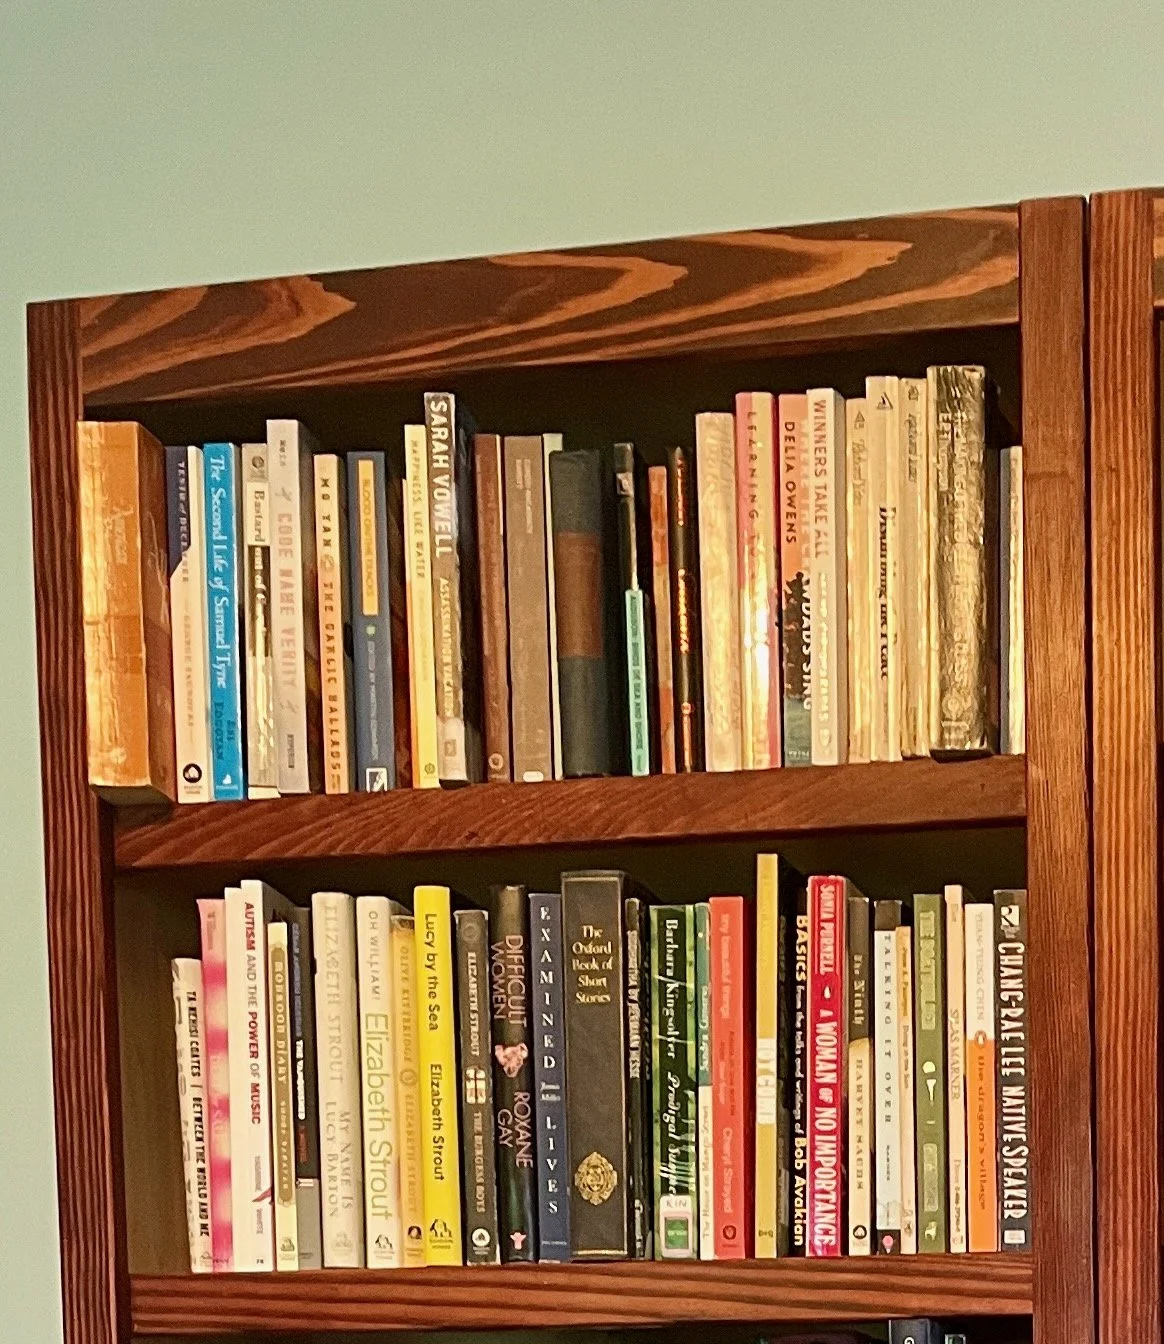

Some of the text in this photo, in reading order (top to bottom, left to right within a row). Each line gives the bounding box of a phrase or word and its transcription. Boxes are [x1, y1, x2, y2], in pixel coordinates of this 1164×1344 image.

[429, 401, 451, 558] SARAH VOWELL
[784, 421, 797, 544] DELIA OWENS
[814, 400, 827, 479] WINNERS
[814, 483, 827, 526] TAKE
[210, 456, 230, 688] The Second Life of Samuel Tyne
[422, 913, 440, 1031] Lucy by the Sea
[582, 924, 603, 940] The
[819, 885, 834, 975] SONIA PURNELL
[245, 902, 261, 1125] AUTISM AND THE POWER OF MUSIC
[491, 942, 506, 1019] WOMEN
[505, 935, 527, 1027] DIFFICULT
[575, 991, 611, 1004] Stories
[577, 975, 607, 989] Short
[365, 1012, 393, 1220] Elizabeth Strout
[429, 1063, 445, 1181] Elizabeth Strout
[999, 941, 1028, 1220] CHANG-RAE LEE NATIVE SPEAKER
[498, 1109, 514, 1148] GAY
[514, 1091, 533, 1168] ROXANE
[814, 1009, 838, 1246] A WOMAN OF NO IMPORTANCE
